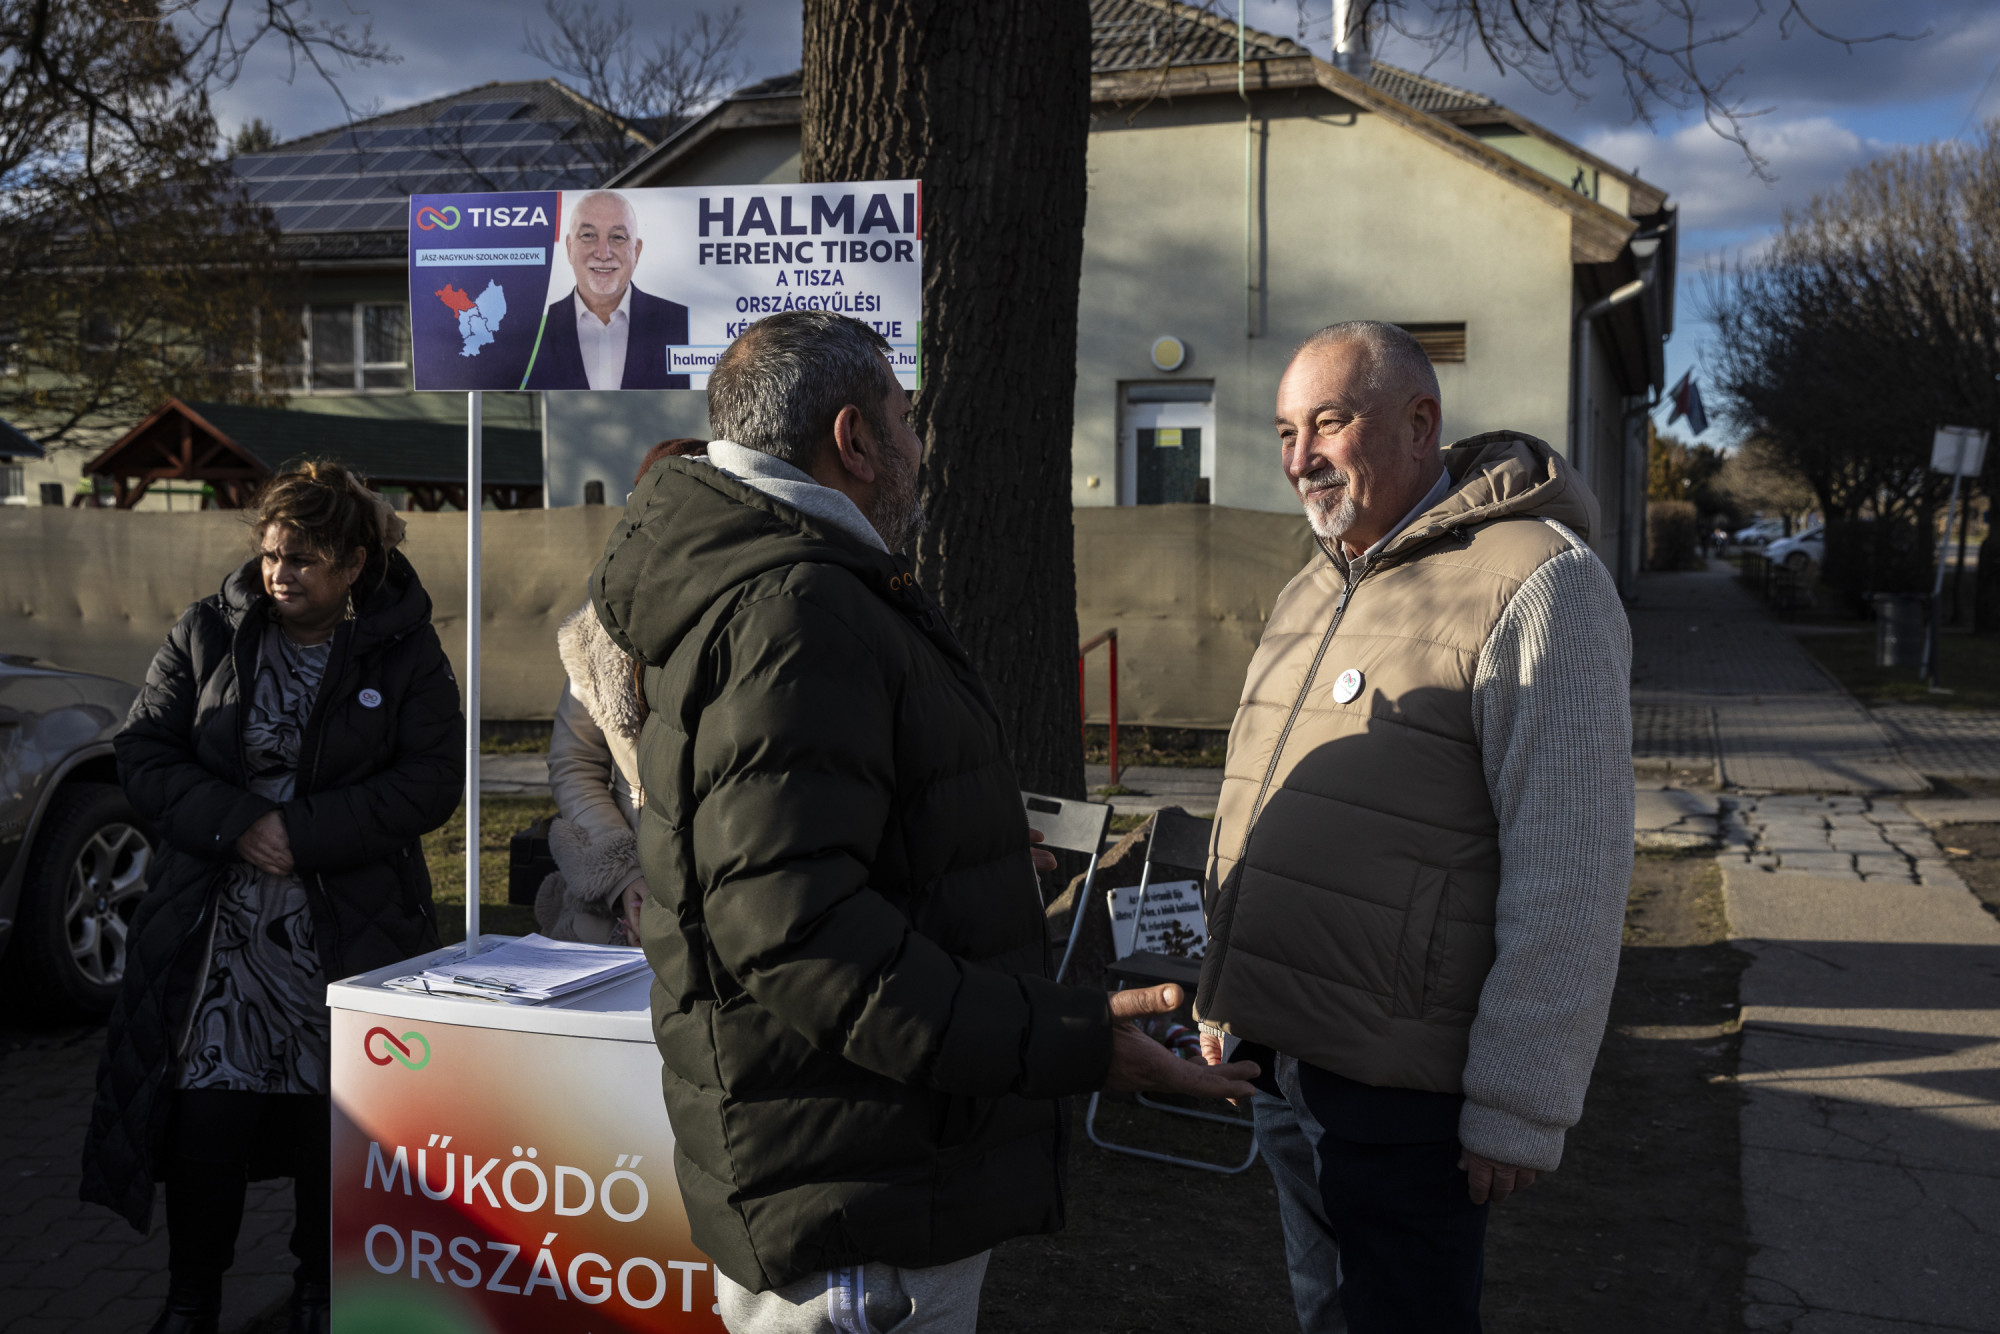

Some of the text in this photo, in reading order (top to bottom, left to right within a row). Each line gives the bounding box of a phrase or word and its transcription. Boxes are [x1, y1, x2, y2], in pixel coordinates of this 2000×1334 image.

[467, 206, 549, 228] TISZA
[699, 193, 915, 237] HALMAI
[421, 252, 540, 262] JÁSZ-NAGYKUN-SZOLNOK 02.OEVK
[699, 240, 915, 265] FERENC TIBOR
[776, 269, 844, 286] A TISZA
[736, 291, 881, 313] ORSZÁGGYŰLÉSI
[364, 1133, 649, 1223] MŰKÖDŐ
[364, 1223, 721, 1316] ORSZÁGOT!
